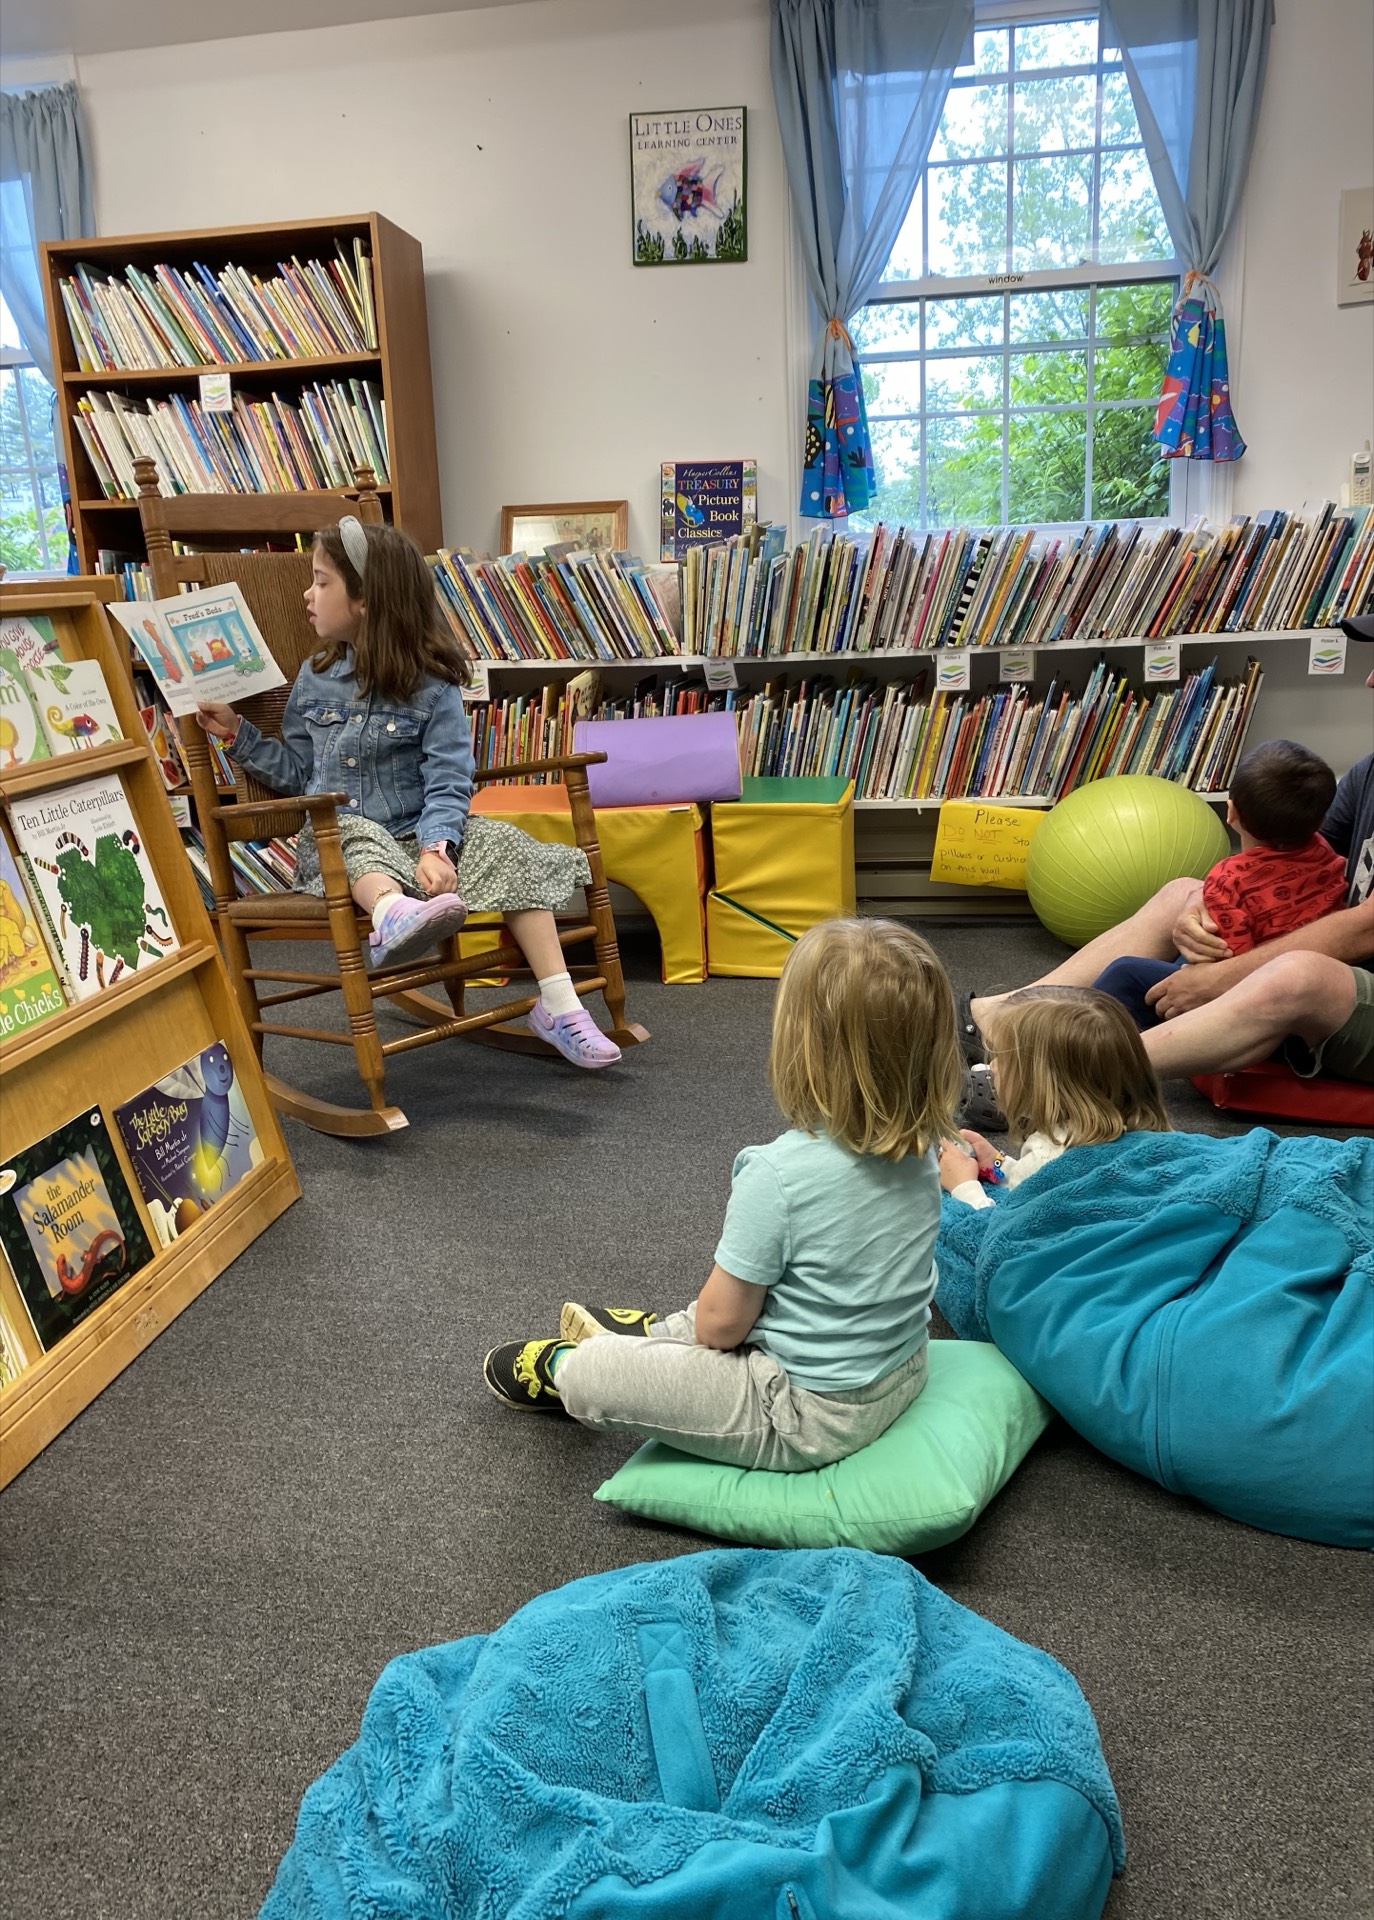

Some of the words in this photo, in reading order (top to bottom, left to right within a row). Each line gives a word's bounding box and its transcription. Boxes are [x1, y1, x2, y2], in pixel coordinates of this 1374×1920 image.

[635, 118, 691, 137] LITTLE
[695, 113, 742, 132] ONES
[637, 138, 691, 150] LEARNING
[696, 136, 738, 146] CENTER
[988, 274, 1025, 285] window
[677, 478, 740, 491] TREASURY
[698, 494, 740, 506] Picture
[709, 510, 739, 522] Book
[677, 527, 723, 539] Classics
[183, 610, 205, 621] Fred's
[17, 814, 40, 831] Ten
[39, 804, 70, 825] Little
[69, 789, 125, 815] Caterpillars
[974, 808, 1021, 827] Please
[974, 828, 1002, 840] NOT
[14, 989, 63, 1025] Chicks
[129, 1112, 146, 1131] The
[142, 1101, 168, 1128] Little
[168, 1101, 188, 1125] Bug
[136, 1117, 171, 1151] Squeegy
[154, 1145, 166, 1161] Bill
[46, 1184, 62, 1203] the
[32, 1176, 97, 1235] Salamander
[50, 1208, 85, 1244] Room
